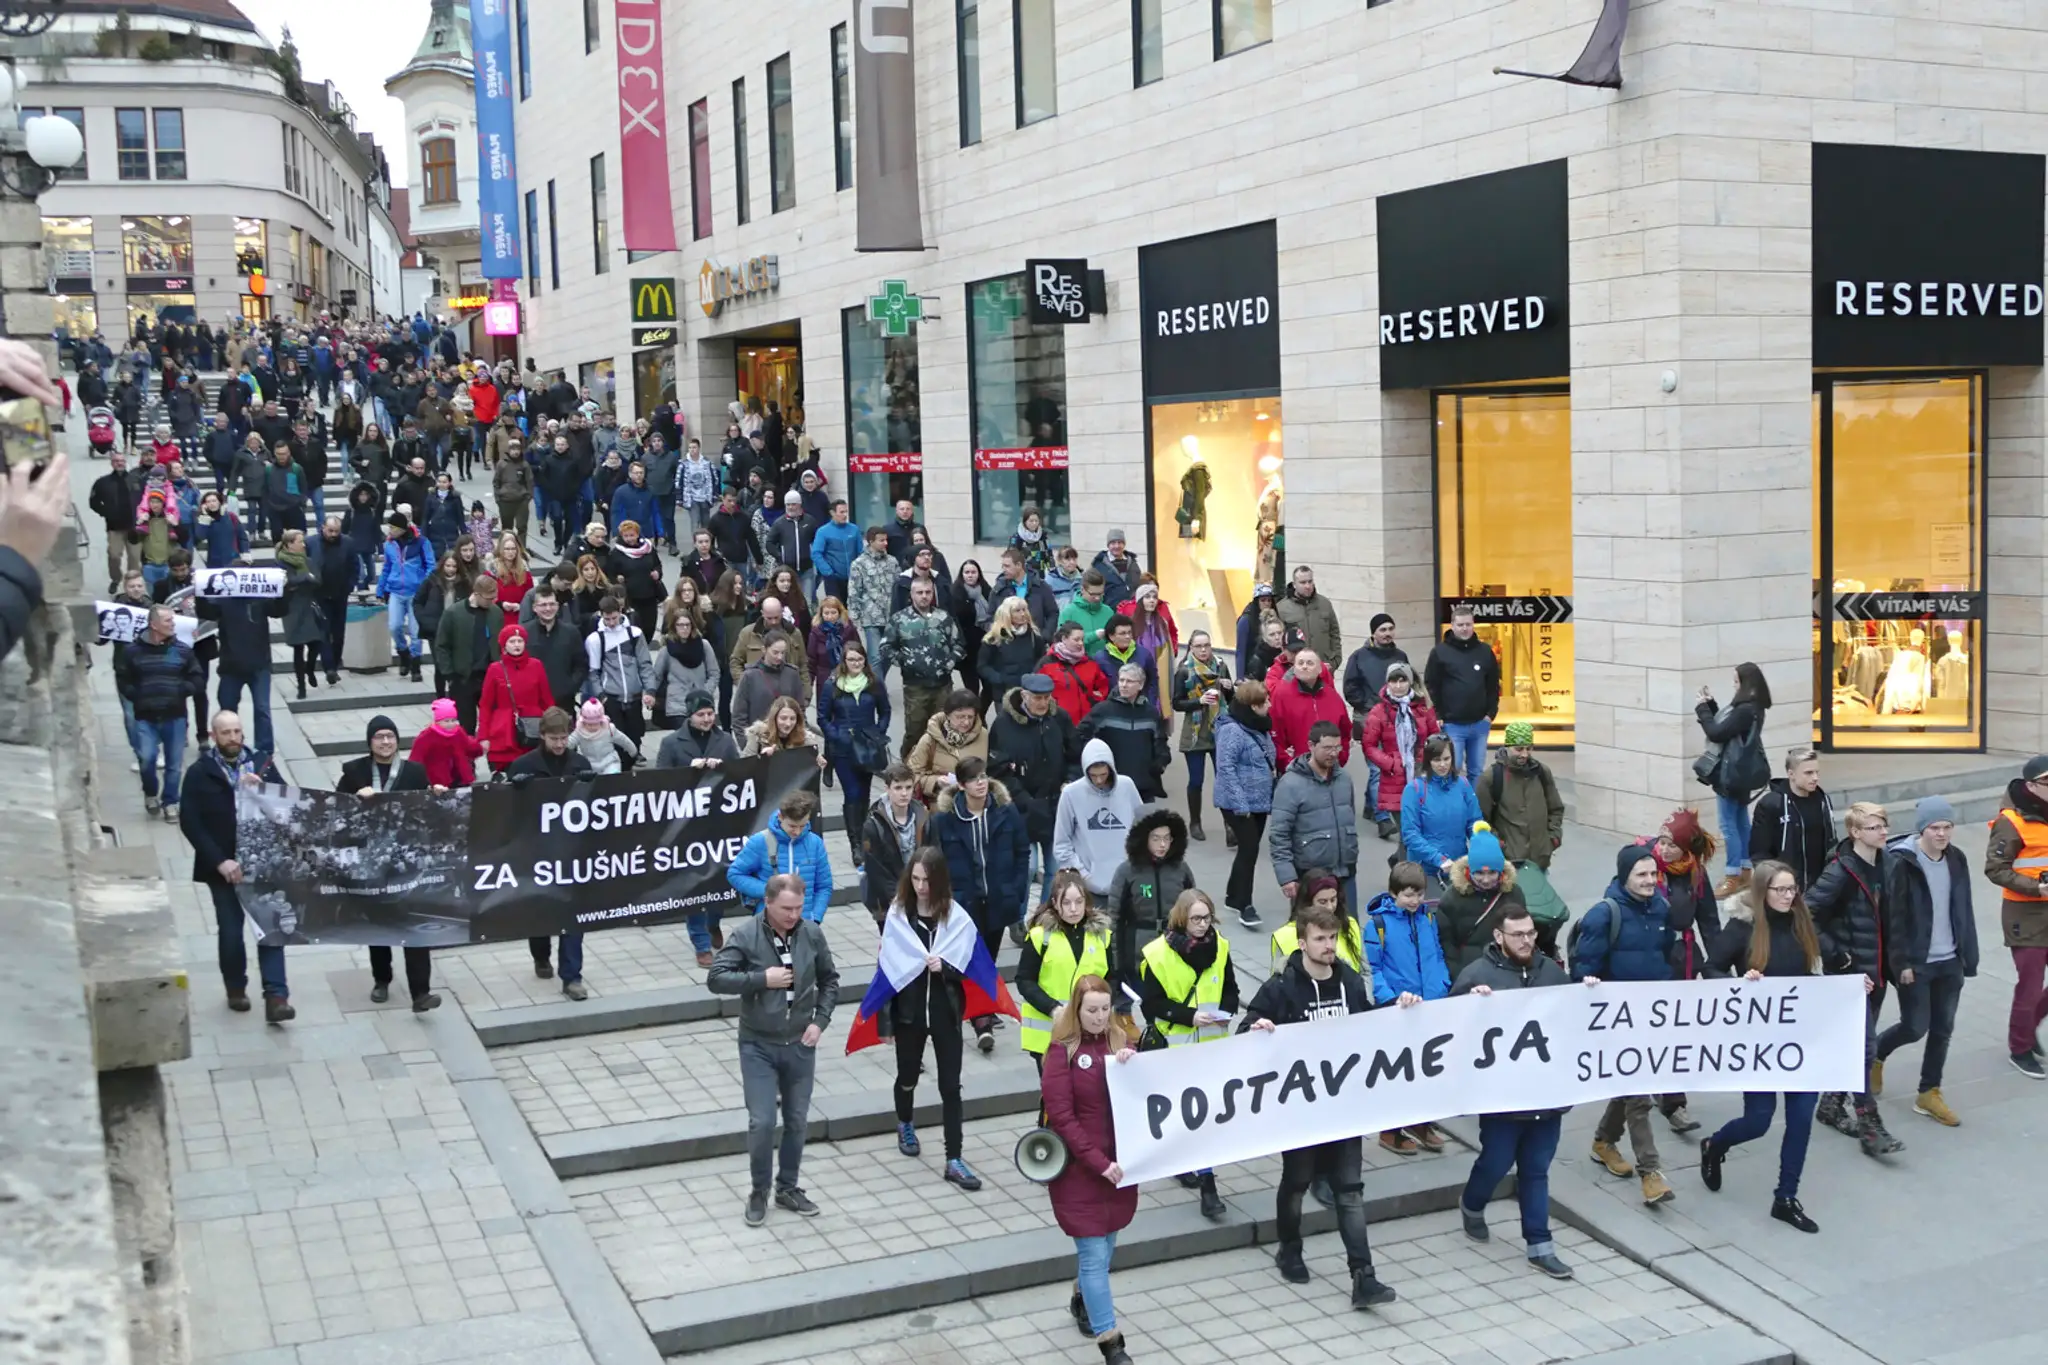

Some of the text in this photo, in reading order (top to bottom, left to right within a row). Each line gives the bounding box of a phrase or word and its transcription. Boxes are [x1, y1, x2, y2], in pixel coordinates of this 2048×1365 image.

[1157, 296, 1270, 337] RESERVED
[1836, 280, 2043, 316] RESERVED
[1379, 296, 1544, 346] RESERVED
[240, 583, 278, 594] FOR JAN
[1876, 595, 1970, 613] VÍTAME VÁS
[1540, 588, 1552, 683] RERVED
[541, 778, 756, 833] POSTAVME SA
[474, 862, 519, 891] ZA
[533, 844, 647, 886] SLUŠNÉ
[576, 888, 737, 924] www.zaslusneslovensko.sk
[1587, 985, 1799, 1031] ZA SLUŠNÉ
[1146, 1020, 1551, 1140] POSTAVME SA
[1577, 1042, 1804, 1082] SLOVENSKO
